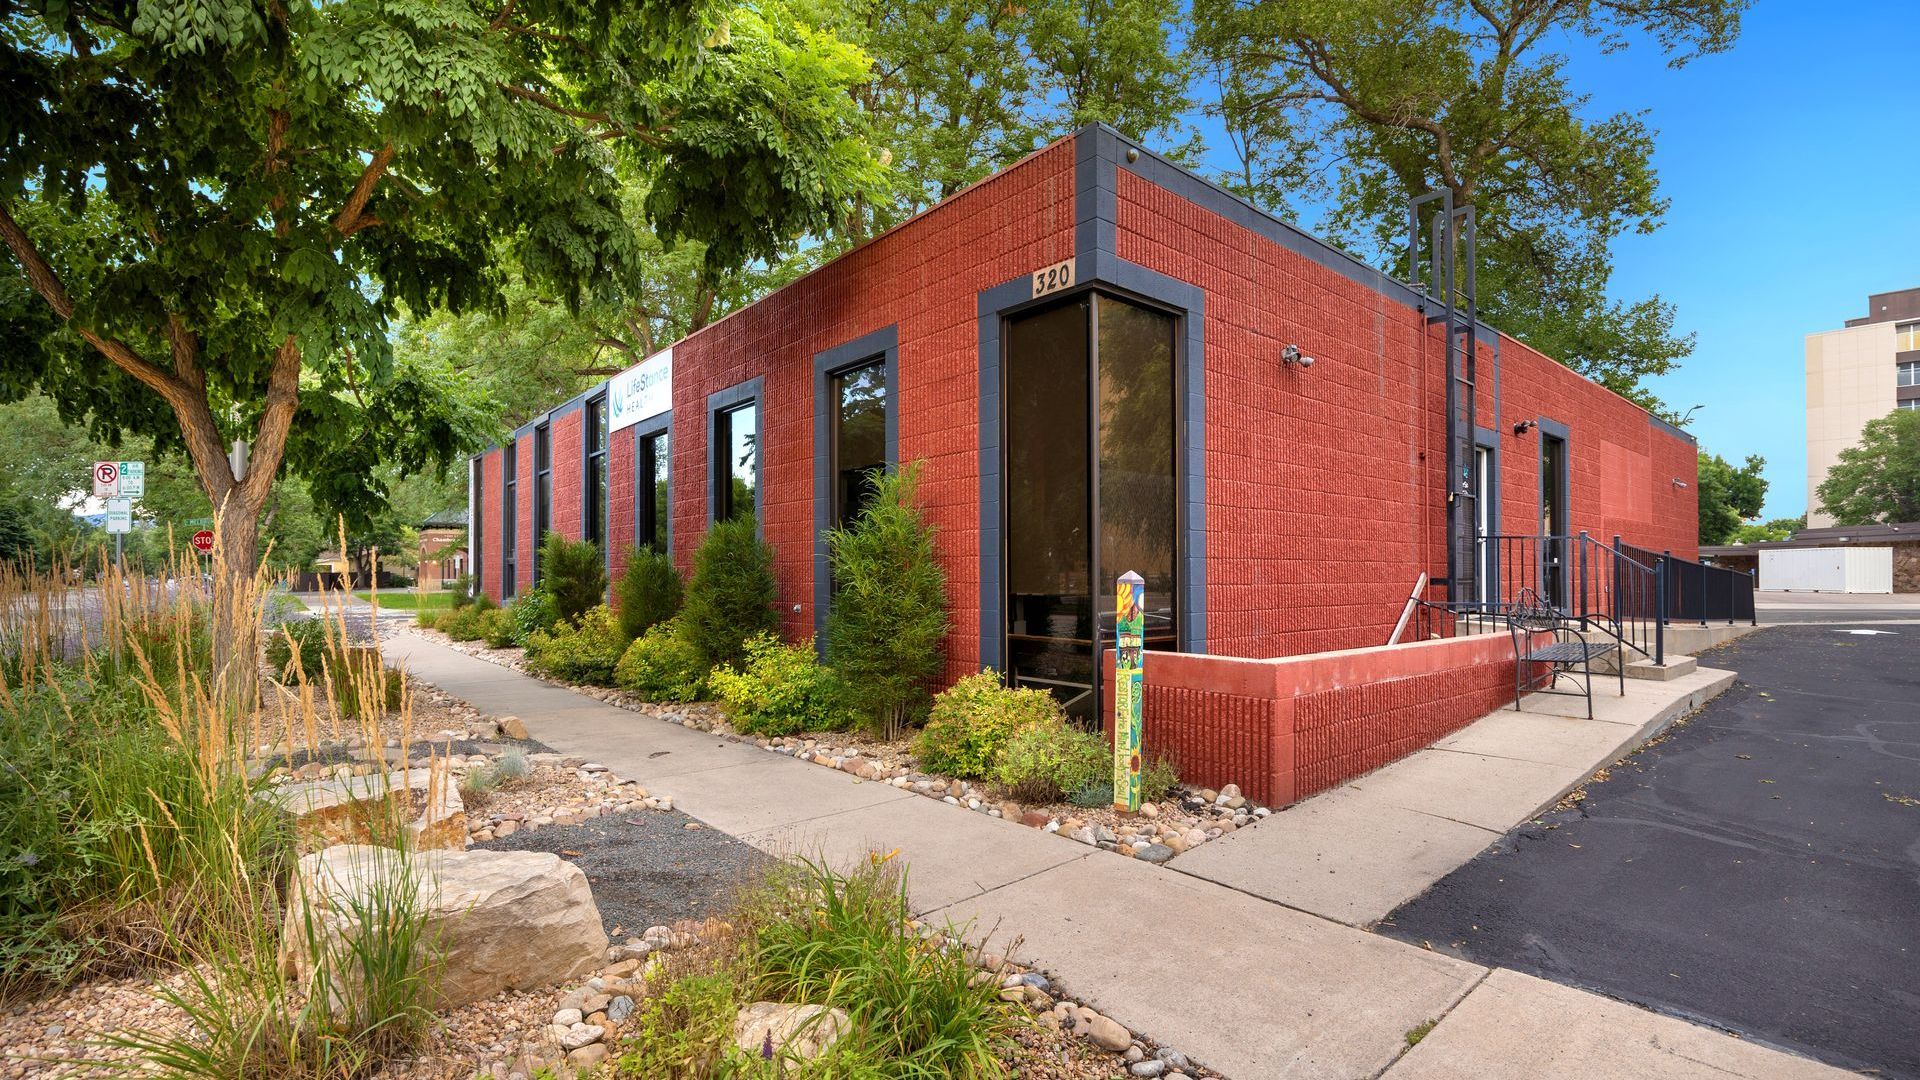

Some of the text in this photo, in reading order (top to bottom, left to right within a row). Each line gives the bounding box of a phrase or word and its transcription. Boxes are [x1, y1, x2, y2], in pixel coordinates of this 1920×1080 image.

[1036, 264, 1069, 294] 320
[626, 365, 669, 398] LifeStance
[121, 464, 127, 475] 2
[194, 536, 213, 545] STO
